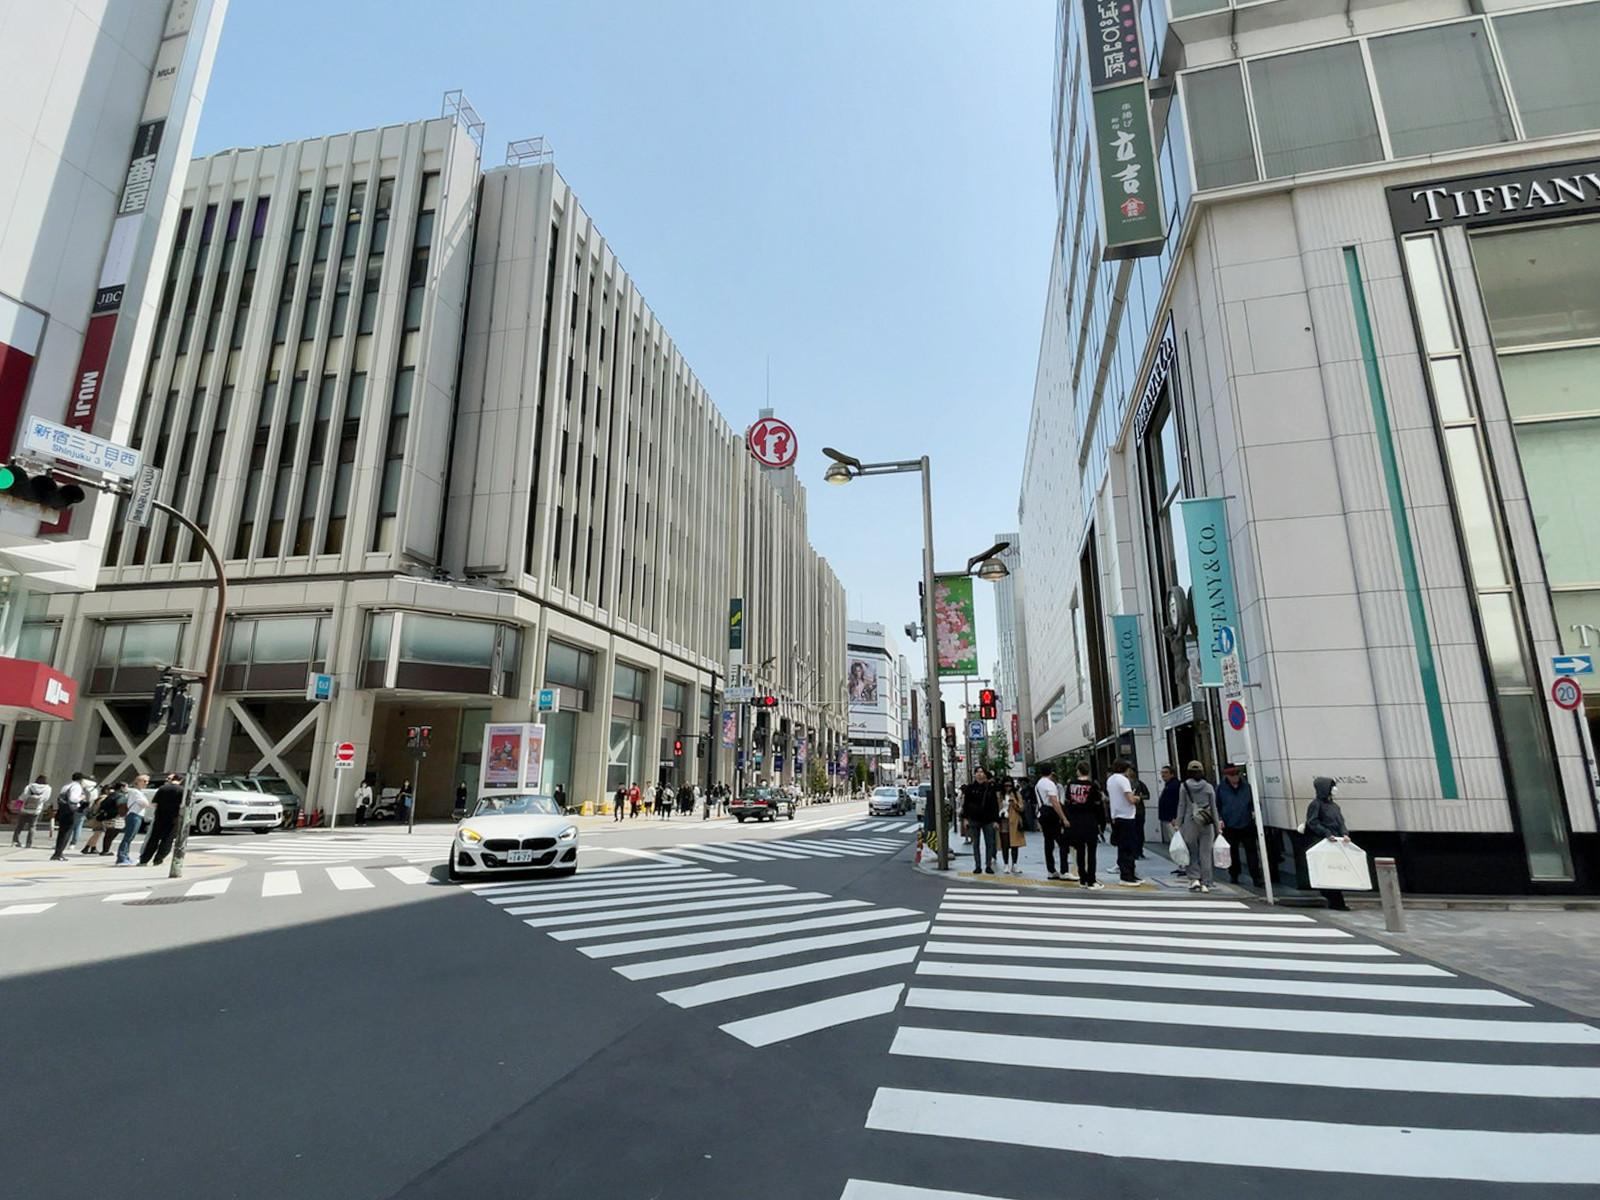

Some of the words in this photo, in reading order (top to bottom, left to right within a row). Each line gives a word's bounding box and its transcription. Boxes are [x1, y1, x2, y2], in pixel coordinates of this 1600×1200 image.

[157, 66, 176, 79] MUJI
[1109, 130, 1142, 194] 立吉
[97, 290, 122, 305] JBC
[74, 371, 99, 418] MUJI
[33, 422, 137, 468] 新宿三丁目西
[52, 443, 92, 464] Shinjuku
[94, 456, 101, 466] 3
[104, 459, 115, 471] W.
[1203, 559, 1221, 574] &
[1126, 663, 1140, 712] TIFFANY
[1557, 685, 1576, 702] 20
